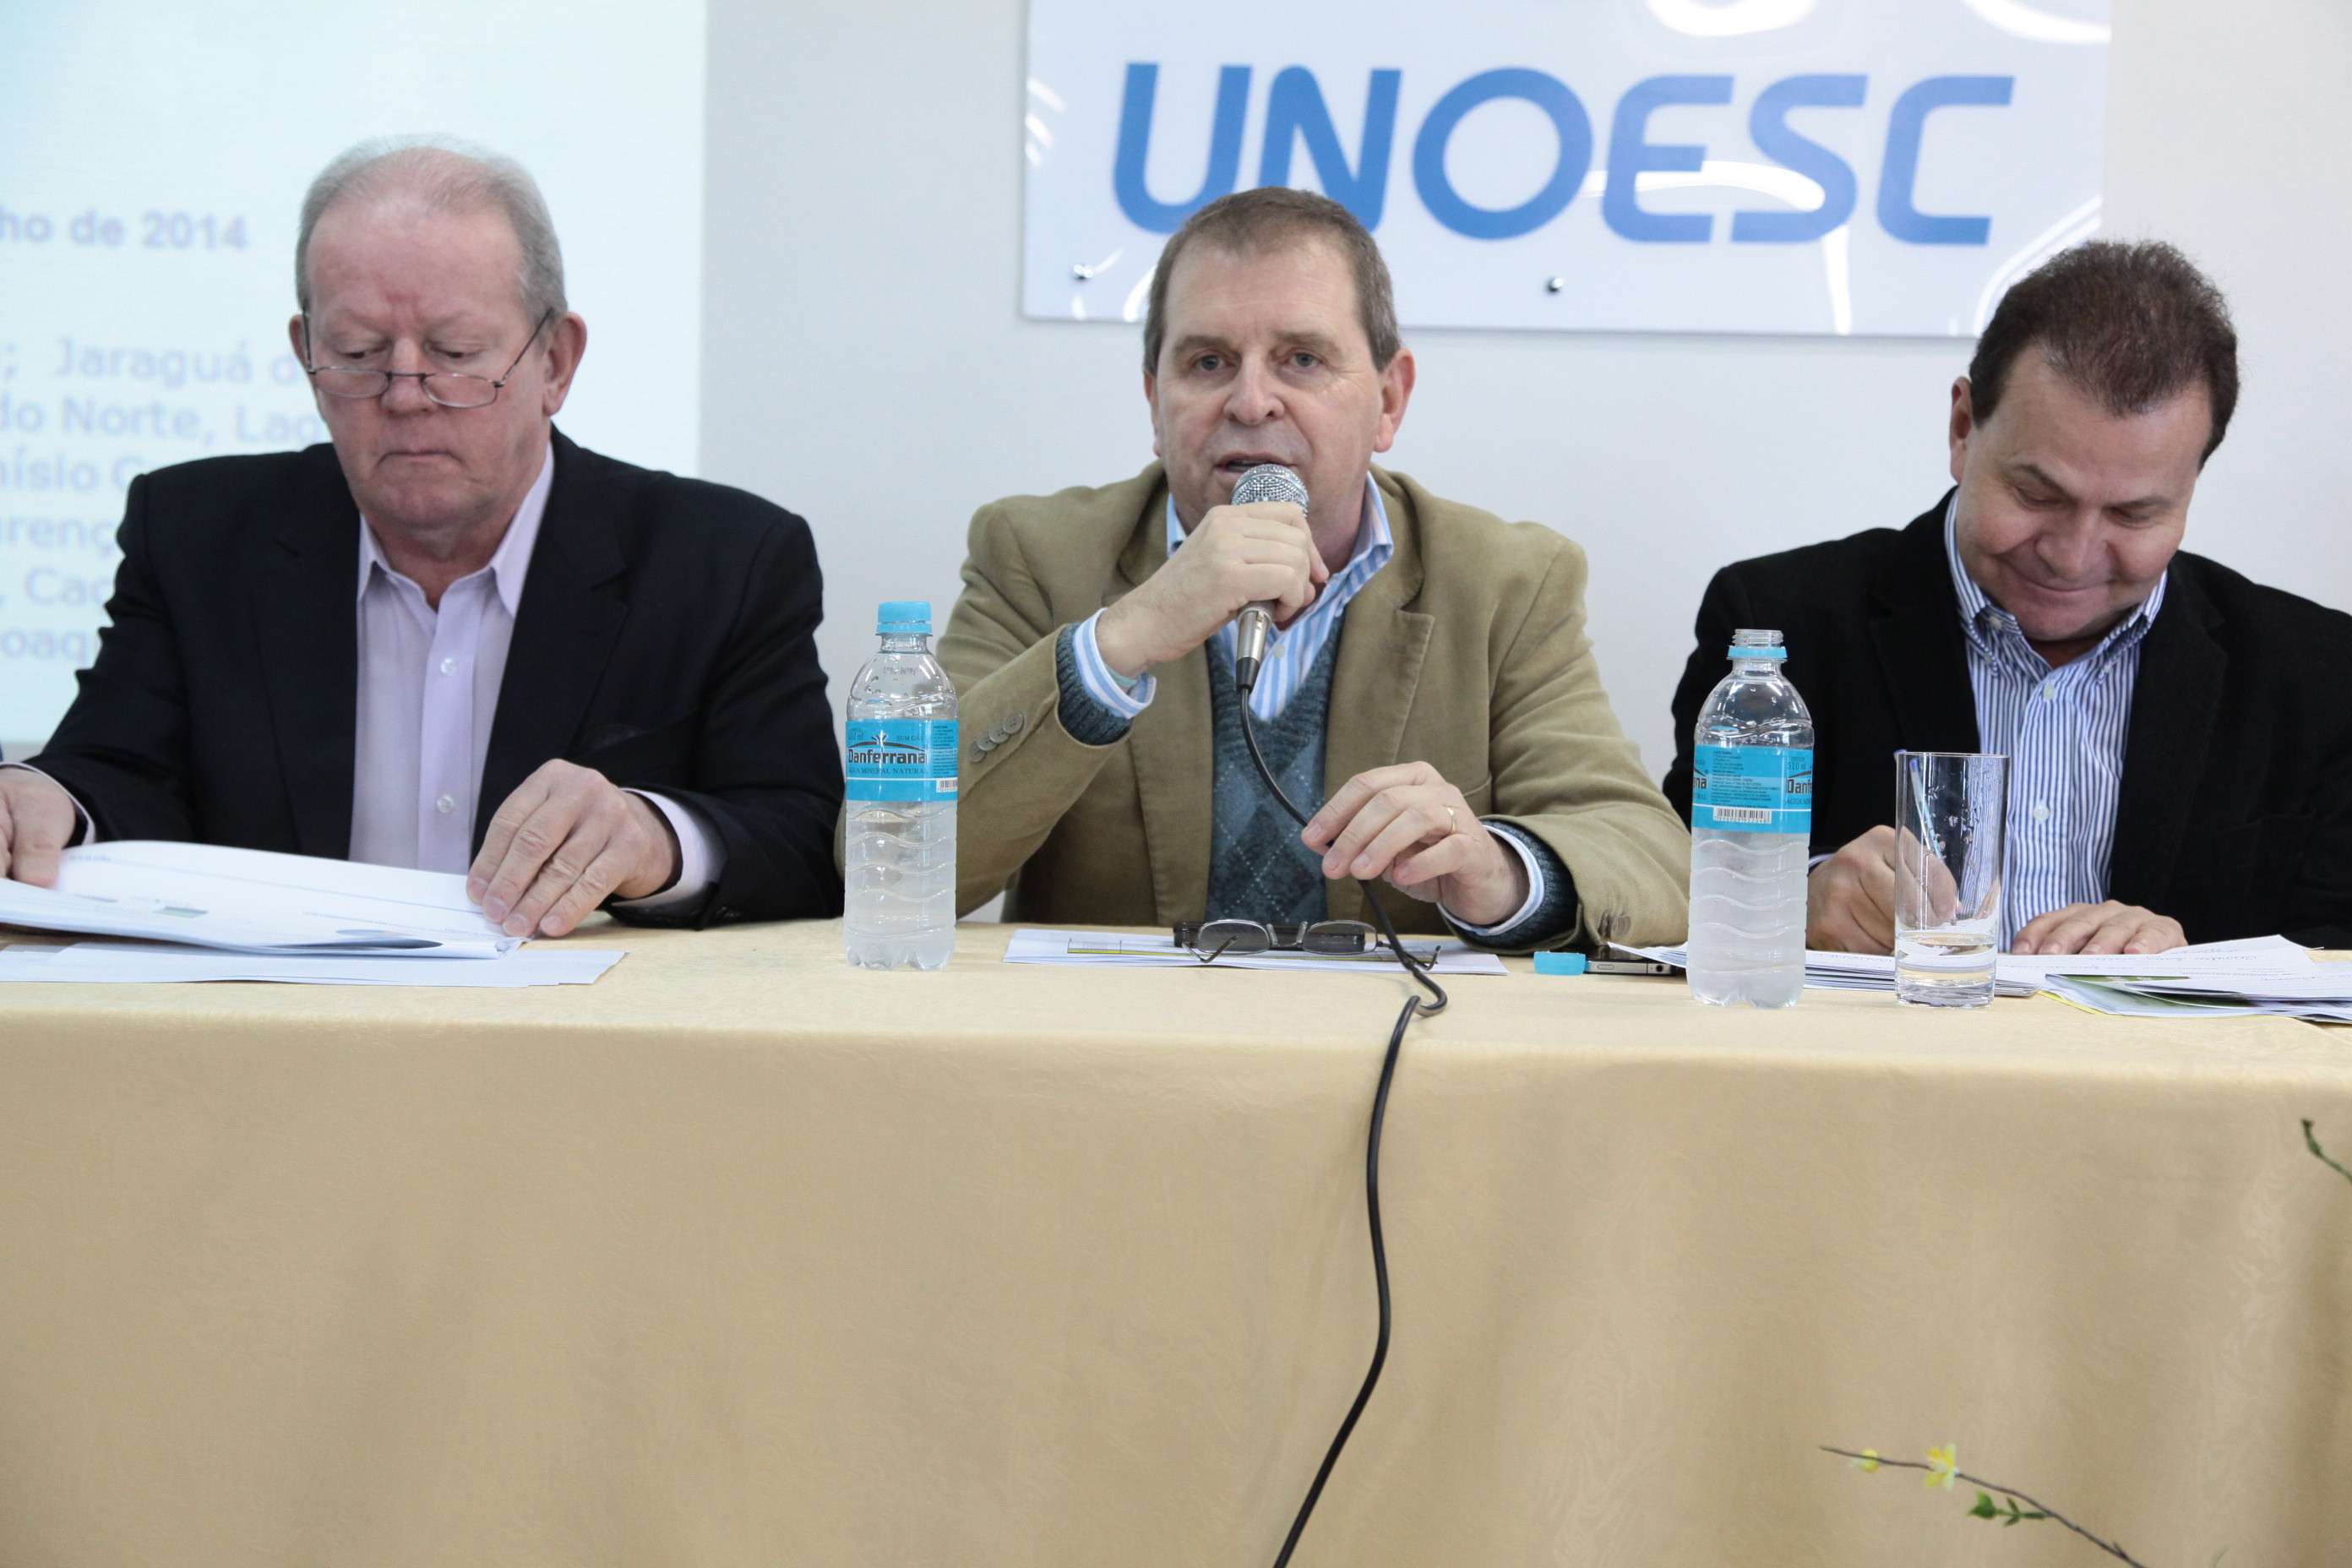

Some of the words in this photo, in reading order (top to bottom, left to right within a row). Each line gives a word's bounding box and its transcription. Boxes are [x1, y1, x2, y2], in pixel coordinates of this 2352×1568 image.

[1113, 62, 2016, 247] UNOESC
[69, 208, 127, 248] de
[141, 210, 250, 252] 2014
[57, 335, 254, 389] Jaraguá
[62, 395, 216, 447] Norte,
[848, 748, 928, 765] Danferrana
